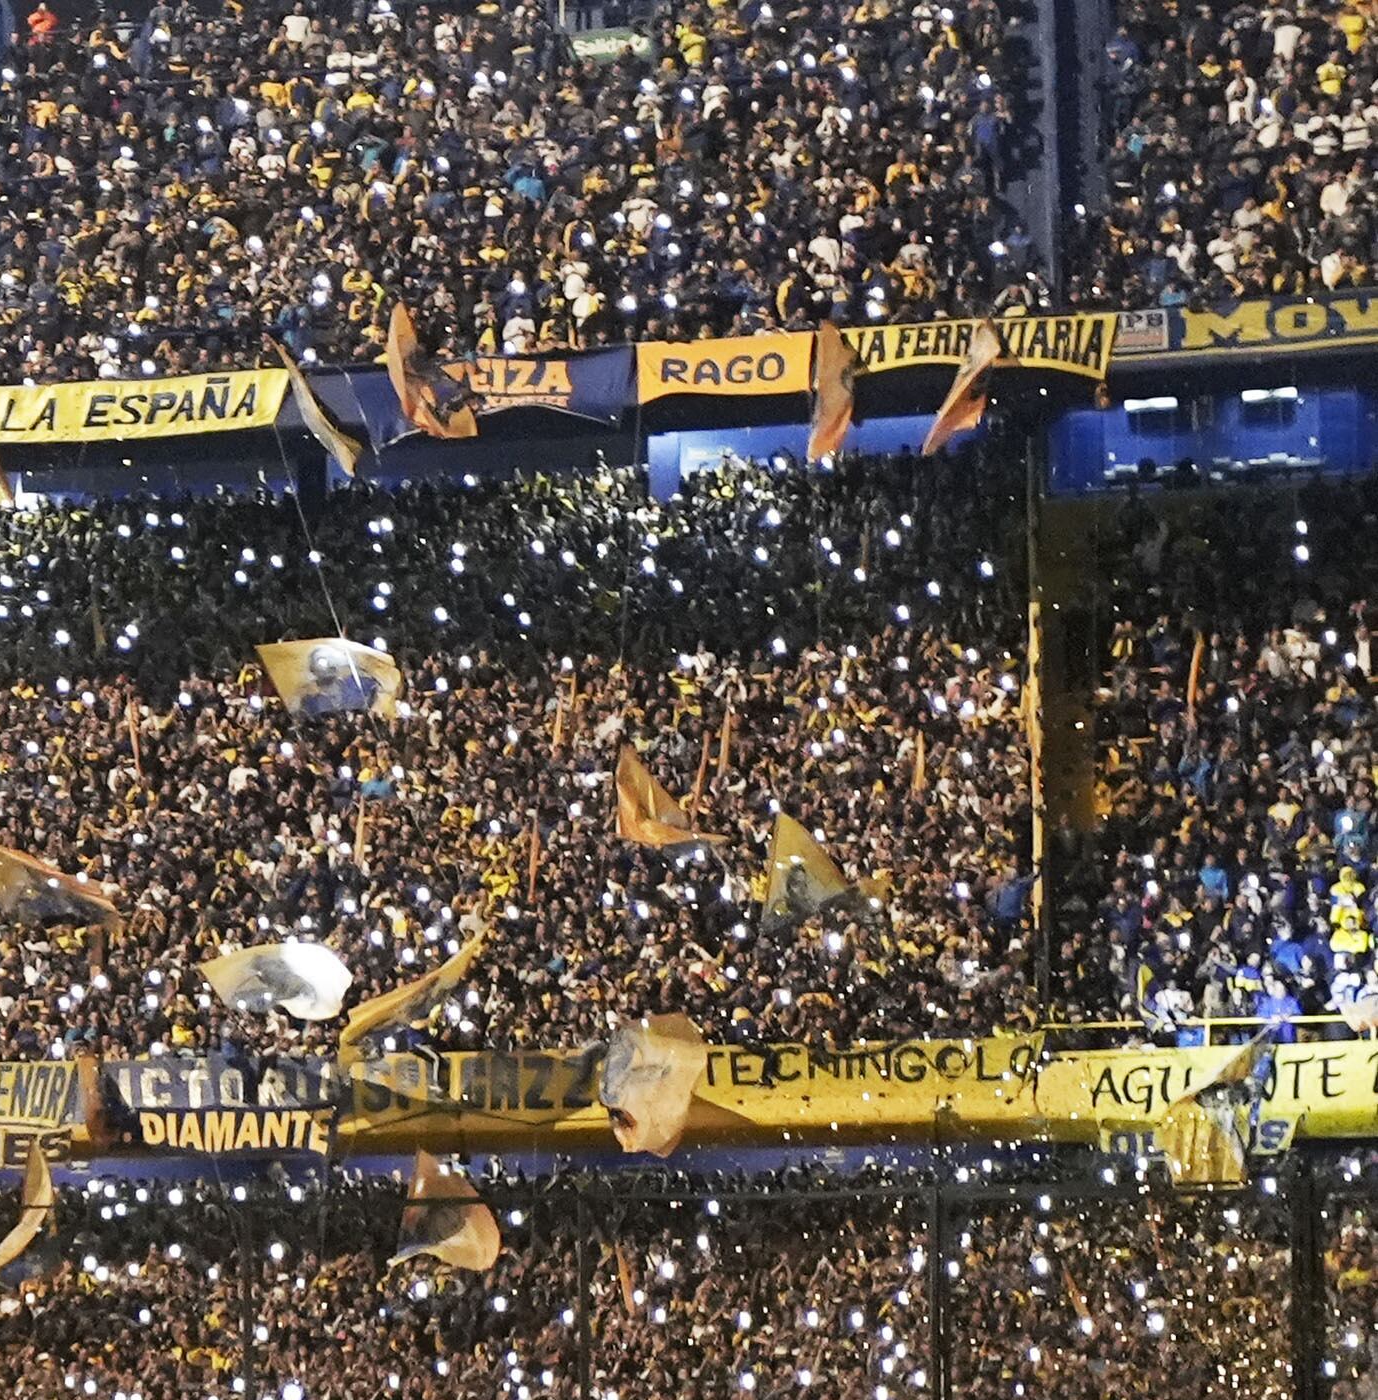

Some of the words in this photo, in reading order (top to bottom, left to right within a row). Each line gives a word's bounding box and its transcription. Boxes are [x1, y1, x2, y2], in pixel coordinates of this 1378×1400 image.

[894, 318, 1104, 366] FERRVIARIA
[660, 351, 787, 385] RAGO
[83, 376, 257, 428] ESPAÑA
[1091, 1046, 1348, 1114] AGUTE
[139, 1108, 334, 1156] DIAMANTE
